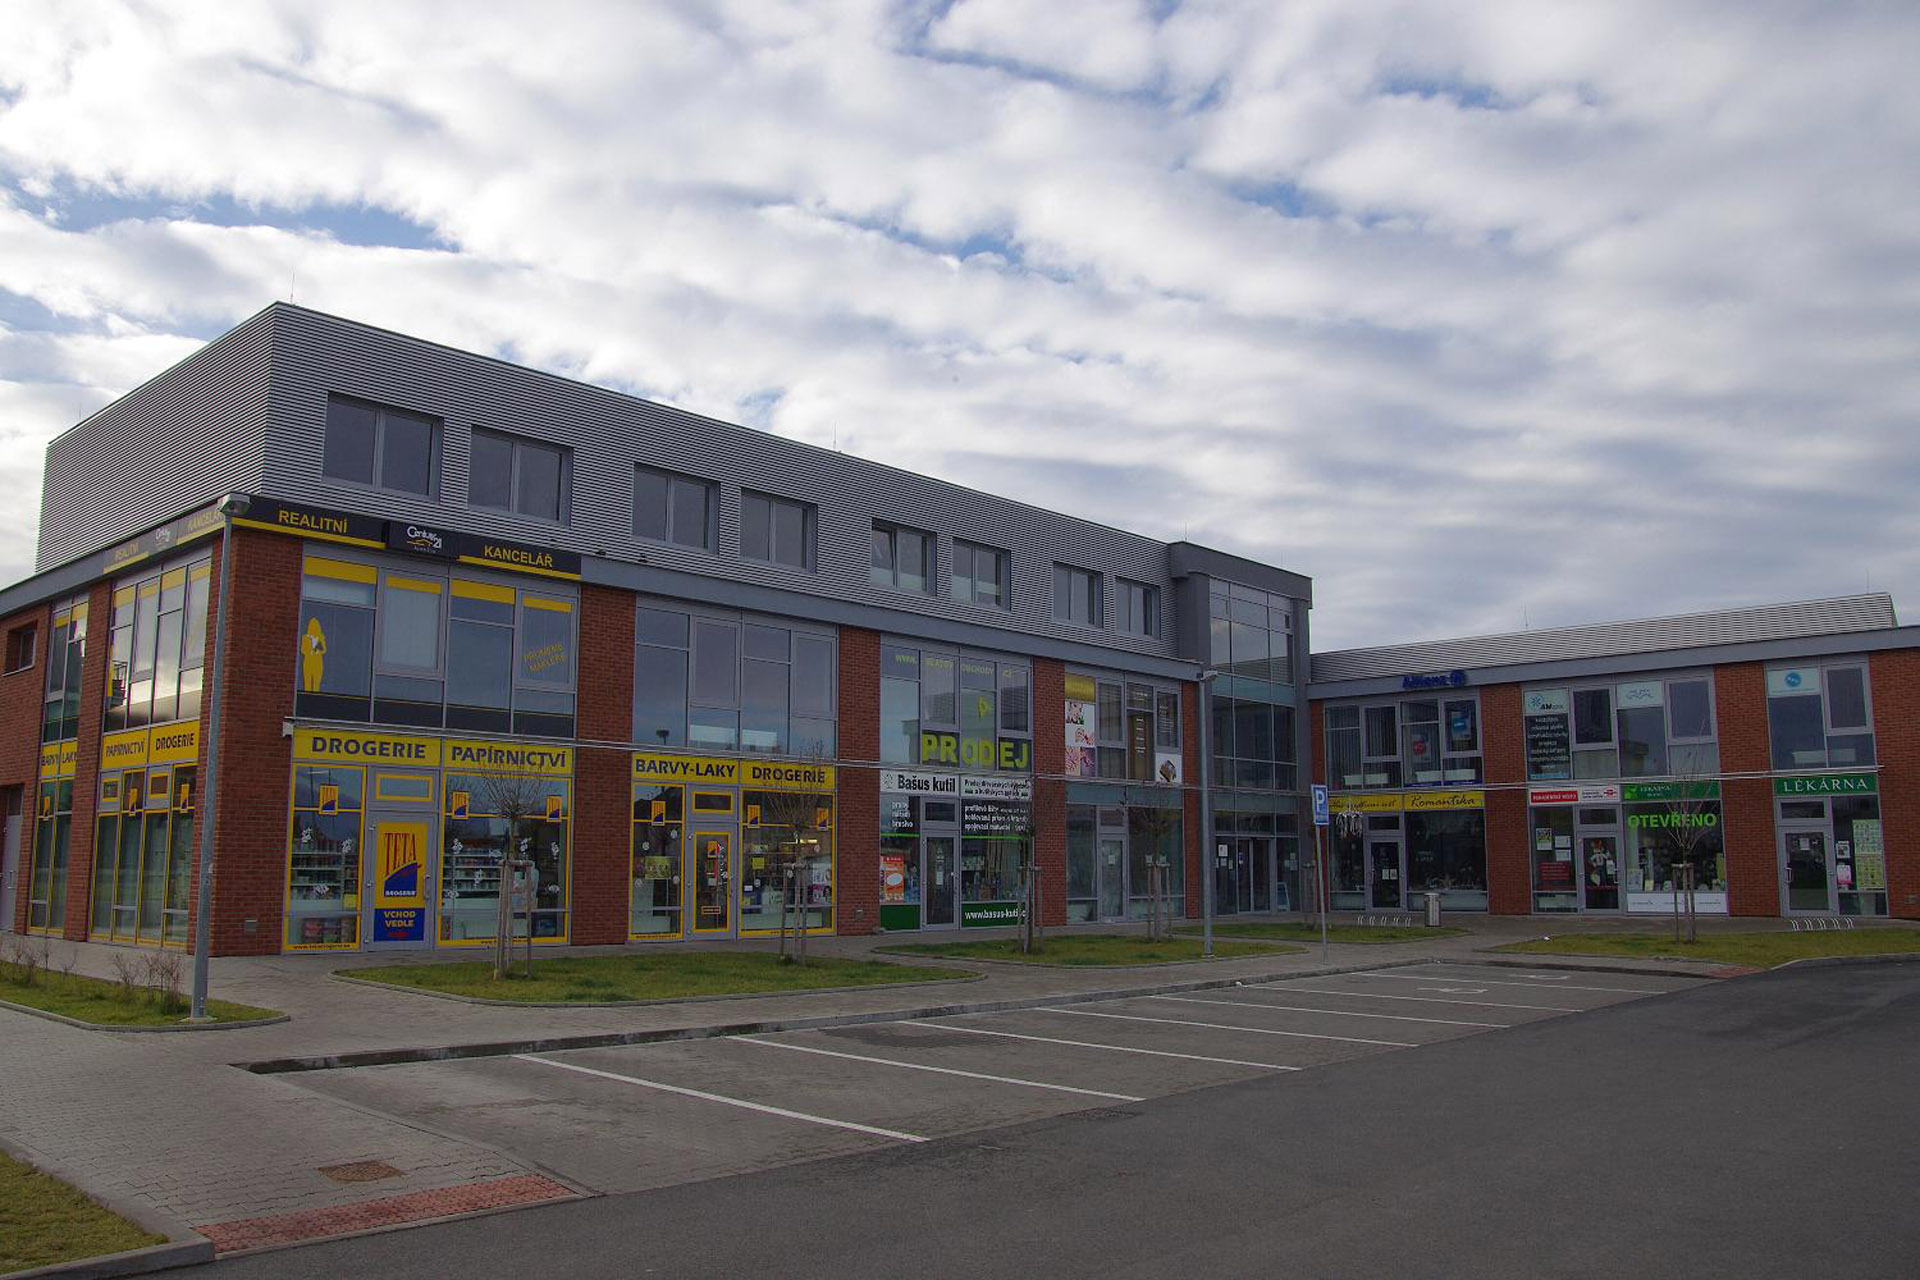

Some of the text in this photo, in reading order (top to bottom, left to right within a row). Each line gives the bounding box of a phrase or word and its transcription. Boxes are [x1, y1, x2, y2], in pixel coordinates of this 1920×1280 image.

[278, 509, 348, 534] REALITNÍ
[484, 545, 553, 568] KANCELÁŘ
[155, 733, 194, 750] DROGERIE
[310, 736, 428, 759] DROGERIE
[921, 733, 1028, 768] PRODEJ
[451, 745, 567, 768] PAPÍRNICTVÍ
[635, 758, 736, 778] BARVY-LAKY
[752, 766, 826, 784] DROGERIE
[898, 774, 956, 793] Bašus kutil
[1783, 777, 1868, 792] LÉKÁRNA
[1315, 789, 1325, 805] P
[1628, 811, 1718, 828] OTEVŘENO
[385, 832, 422, 880] TETA
[384, 910, 416, 919] VCHOD
[964, 908, 1027, 920] www.basus-kuti.c
[385, 919, 415, 928] VEDLE
